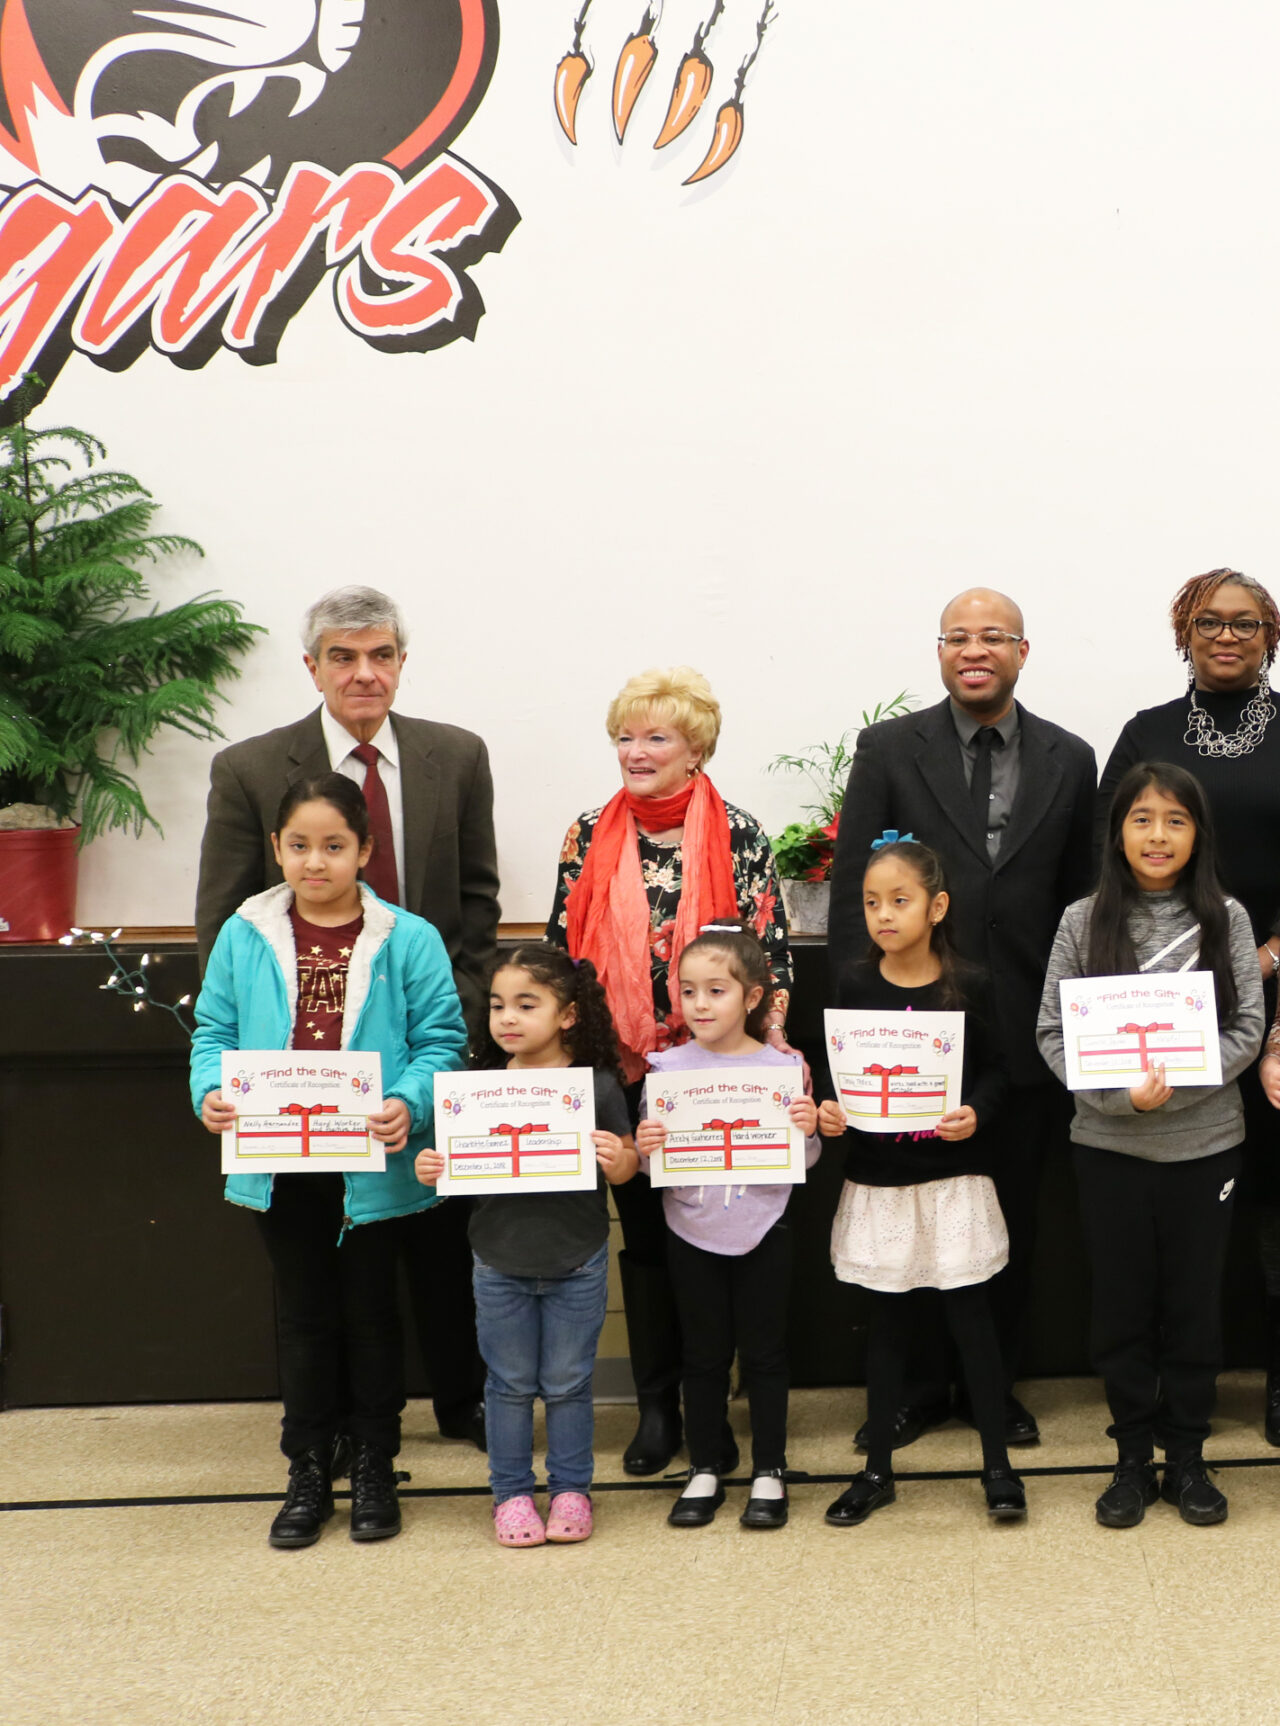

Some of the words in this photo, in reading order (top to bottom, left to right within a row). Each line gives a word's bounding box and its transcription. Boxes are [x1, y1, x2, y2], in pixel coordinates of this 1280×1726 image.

[1131, 990, 1150, 998] the
[850, 1028, 875, 1039] "Find
[879, 1028, 898, 1036] the
[902, 1029, 928, 1040] Gift"
[889, 1042, 921, 1050] Recognition
[261, 1067, 292, 1079] "Find
[297, 1067, 317, 1076] the
[321, 1068, 347, 1080] Gift"
[471, 1088, 502, 1100] "Find
[507, 1086, 526, 1095] the
[531, 1087, 558, 1097] Gift"
[684, 1085, 713, 1097] "Find
[718, 1084, 737, 1092] the
[742, 1084, 768, 1095] Gift"
[518, 1101, 550, 1109] Recognition
[729, 1097, 761, 1105] Recognition
